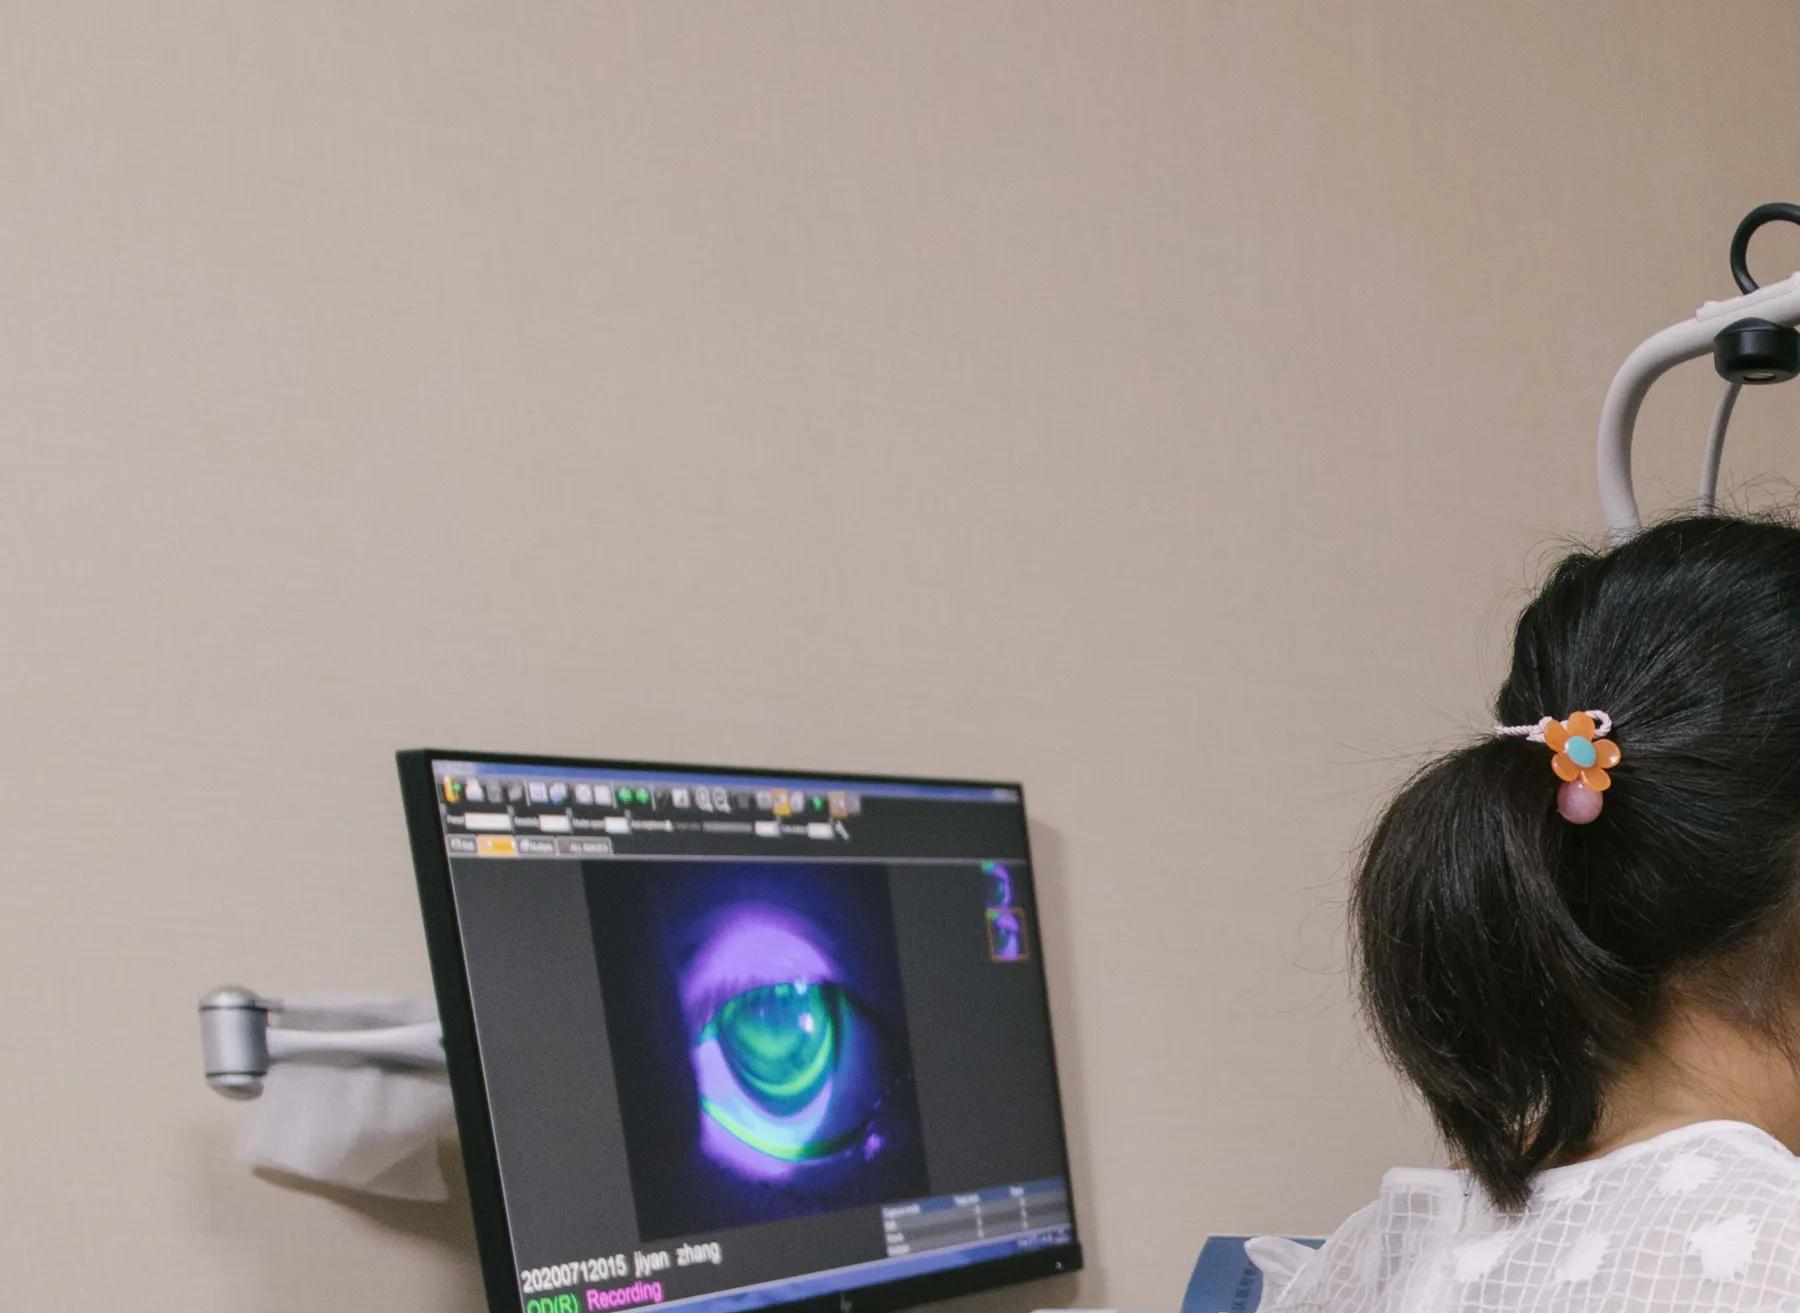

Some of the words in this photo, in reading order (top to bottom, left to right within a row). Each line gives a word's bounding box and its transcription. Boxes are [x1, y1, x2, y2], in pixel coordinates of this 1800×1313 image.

[520, 1253, 628, 1294] 20200712015
[634, 1249, 670, 1278] jiyan
[676, 1241, 721, 1266] zhang
[586, 1280, 664, 1311] Recording
